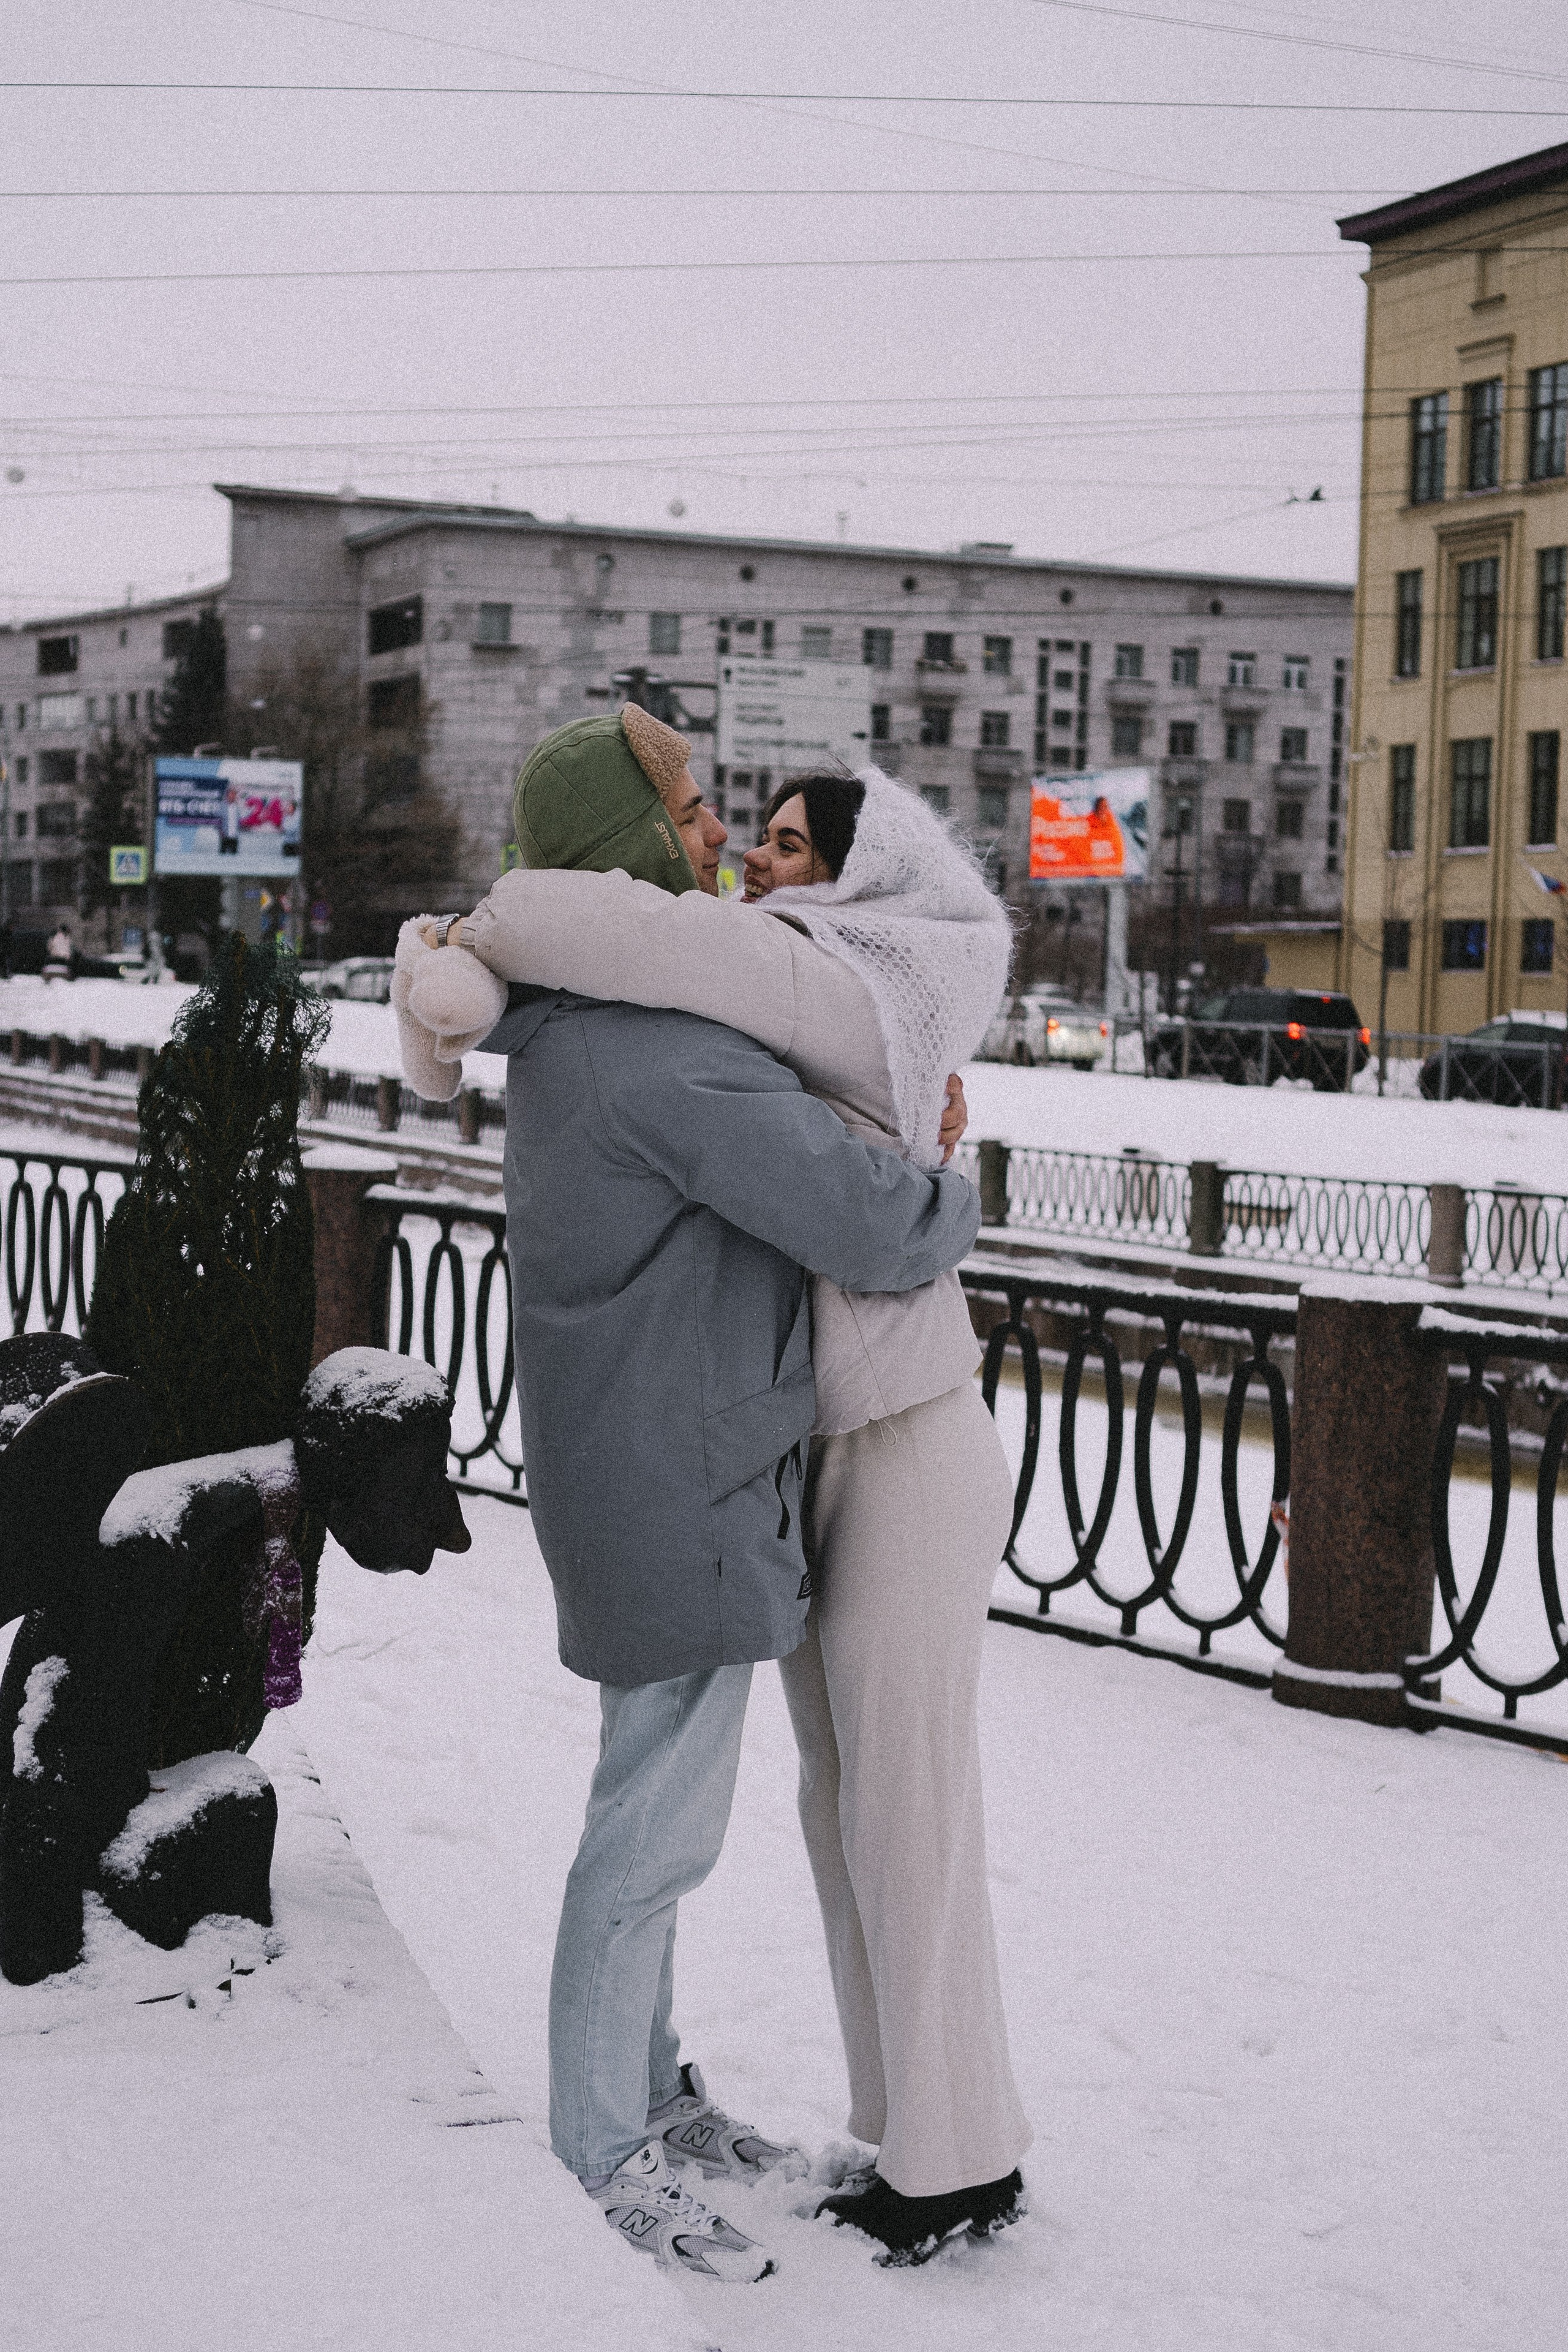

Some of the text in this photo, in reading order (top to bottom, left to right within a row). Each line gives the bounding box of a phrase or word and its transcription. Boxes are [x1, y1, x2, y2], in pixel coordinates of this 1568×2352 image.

[239, 796, 284, 829] 24
[654, 821, 679, 859] EXHAUST
[680, 2123, 715, 2149] N
[619, 2208, 658, 2237] N
